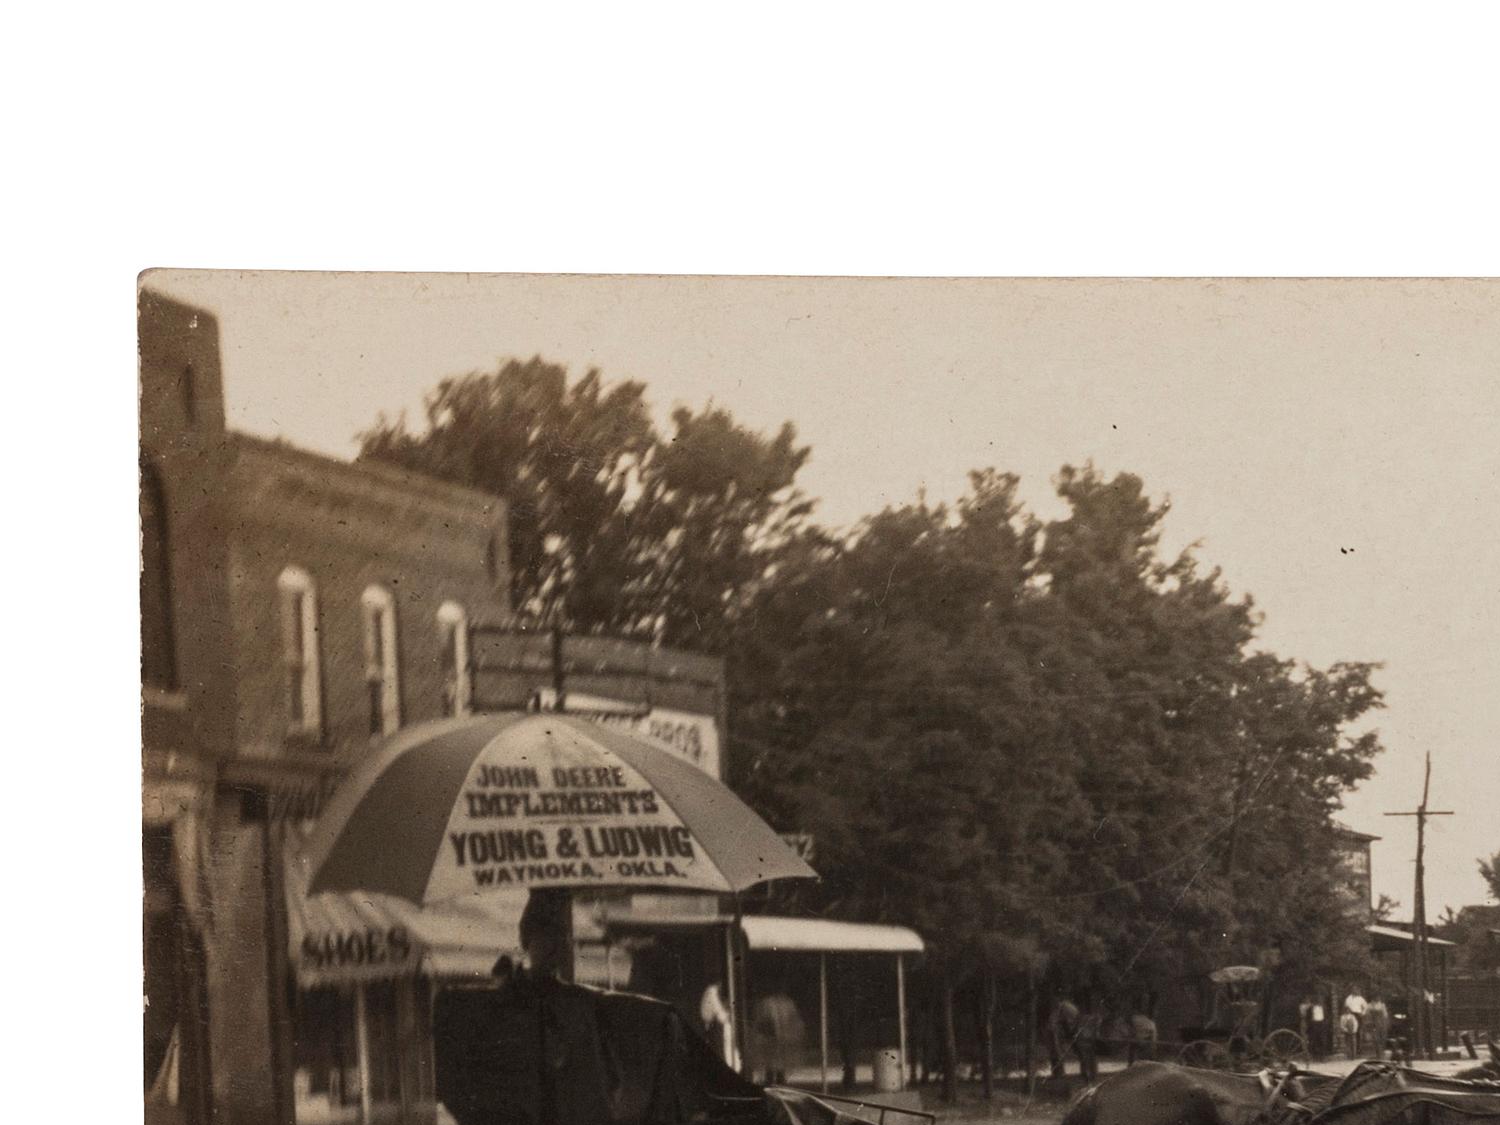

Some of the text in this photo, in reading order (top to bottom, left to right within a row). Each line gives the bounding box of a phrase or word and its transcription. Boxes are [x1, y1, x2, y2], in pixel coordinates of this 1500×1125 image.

[477, 765, 627, 789] JOHN DEERE
[465, 788, 660, 819] IMPLEMENTS
[450, 825, 694, 866] YOUNG & LUDWIG
[301, 923, 410, 967] SHOES
